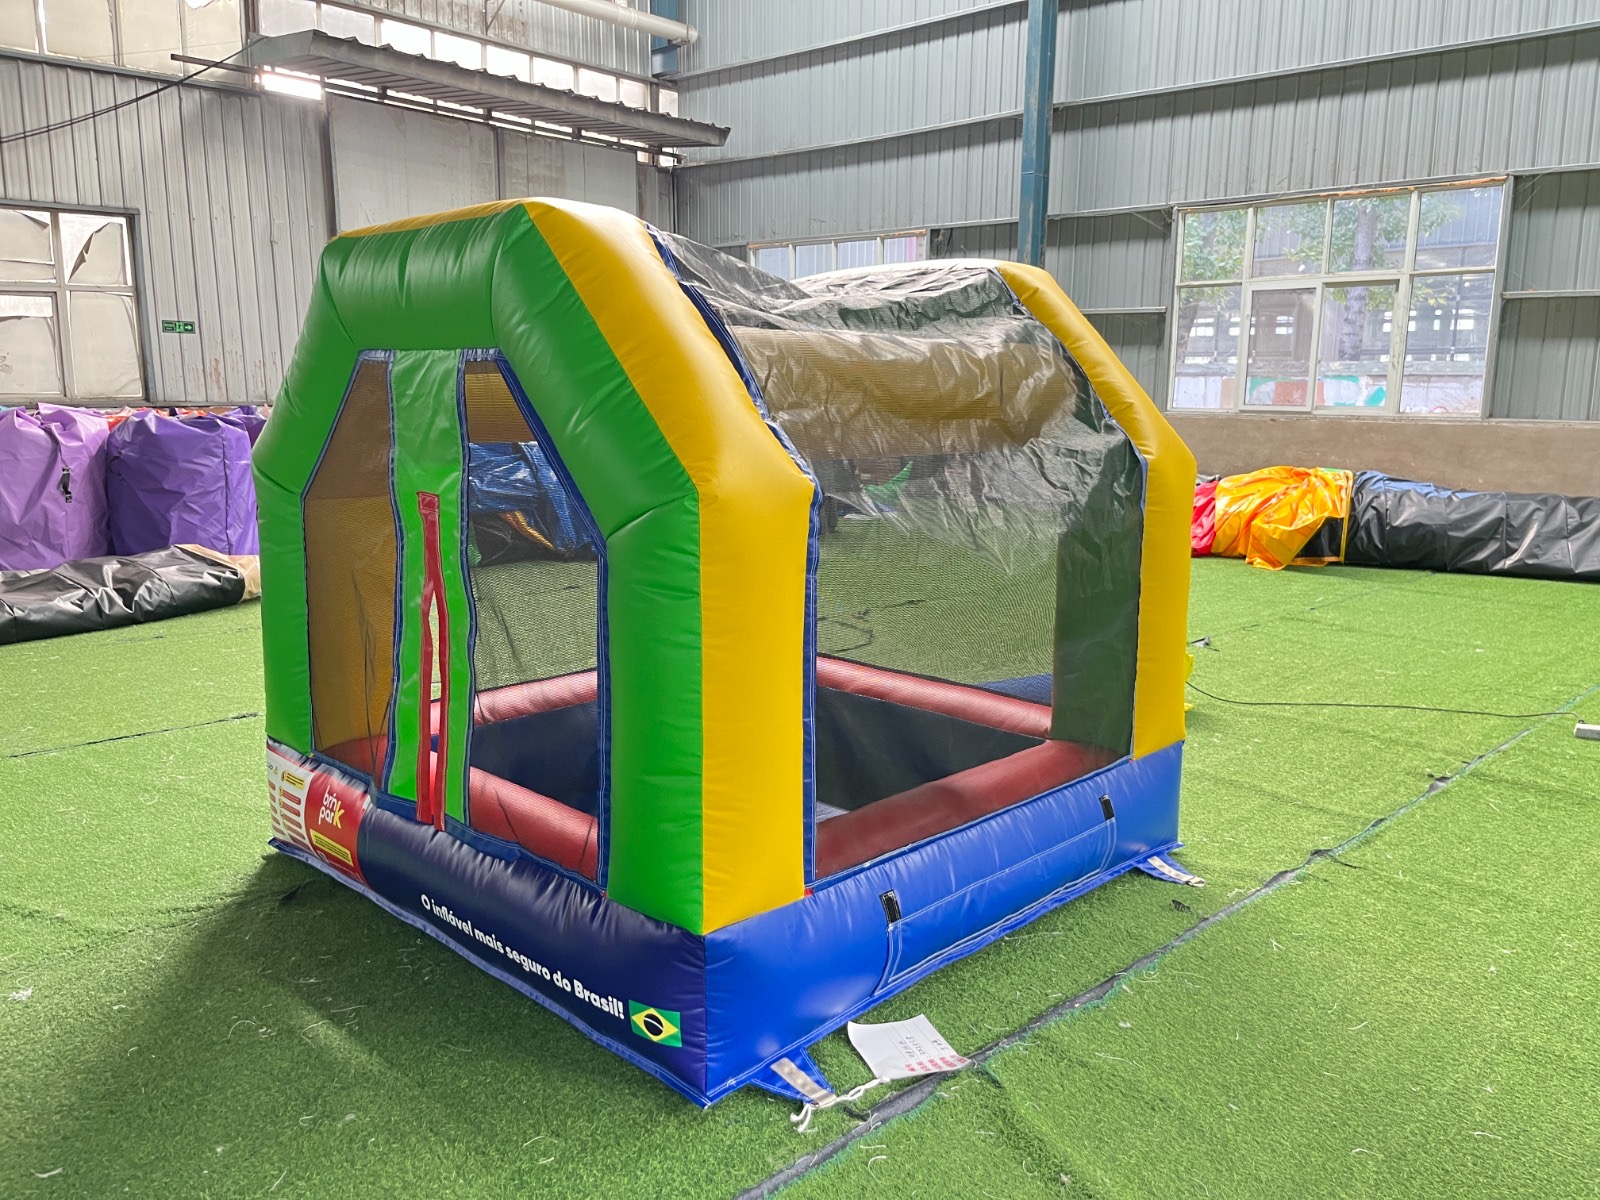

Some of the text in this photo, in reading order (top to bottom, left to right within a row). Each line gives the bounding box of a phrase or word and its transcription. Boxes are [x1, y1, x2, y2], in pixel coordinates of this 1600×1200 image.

[420, 894, 625, 1020] O inflável mais seguro do Brasil!
